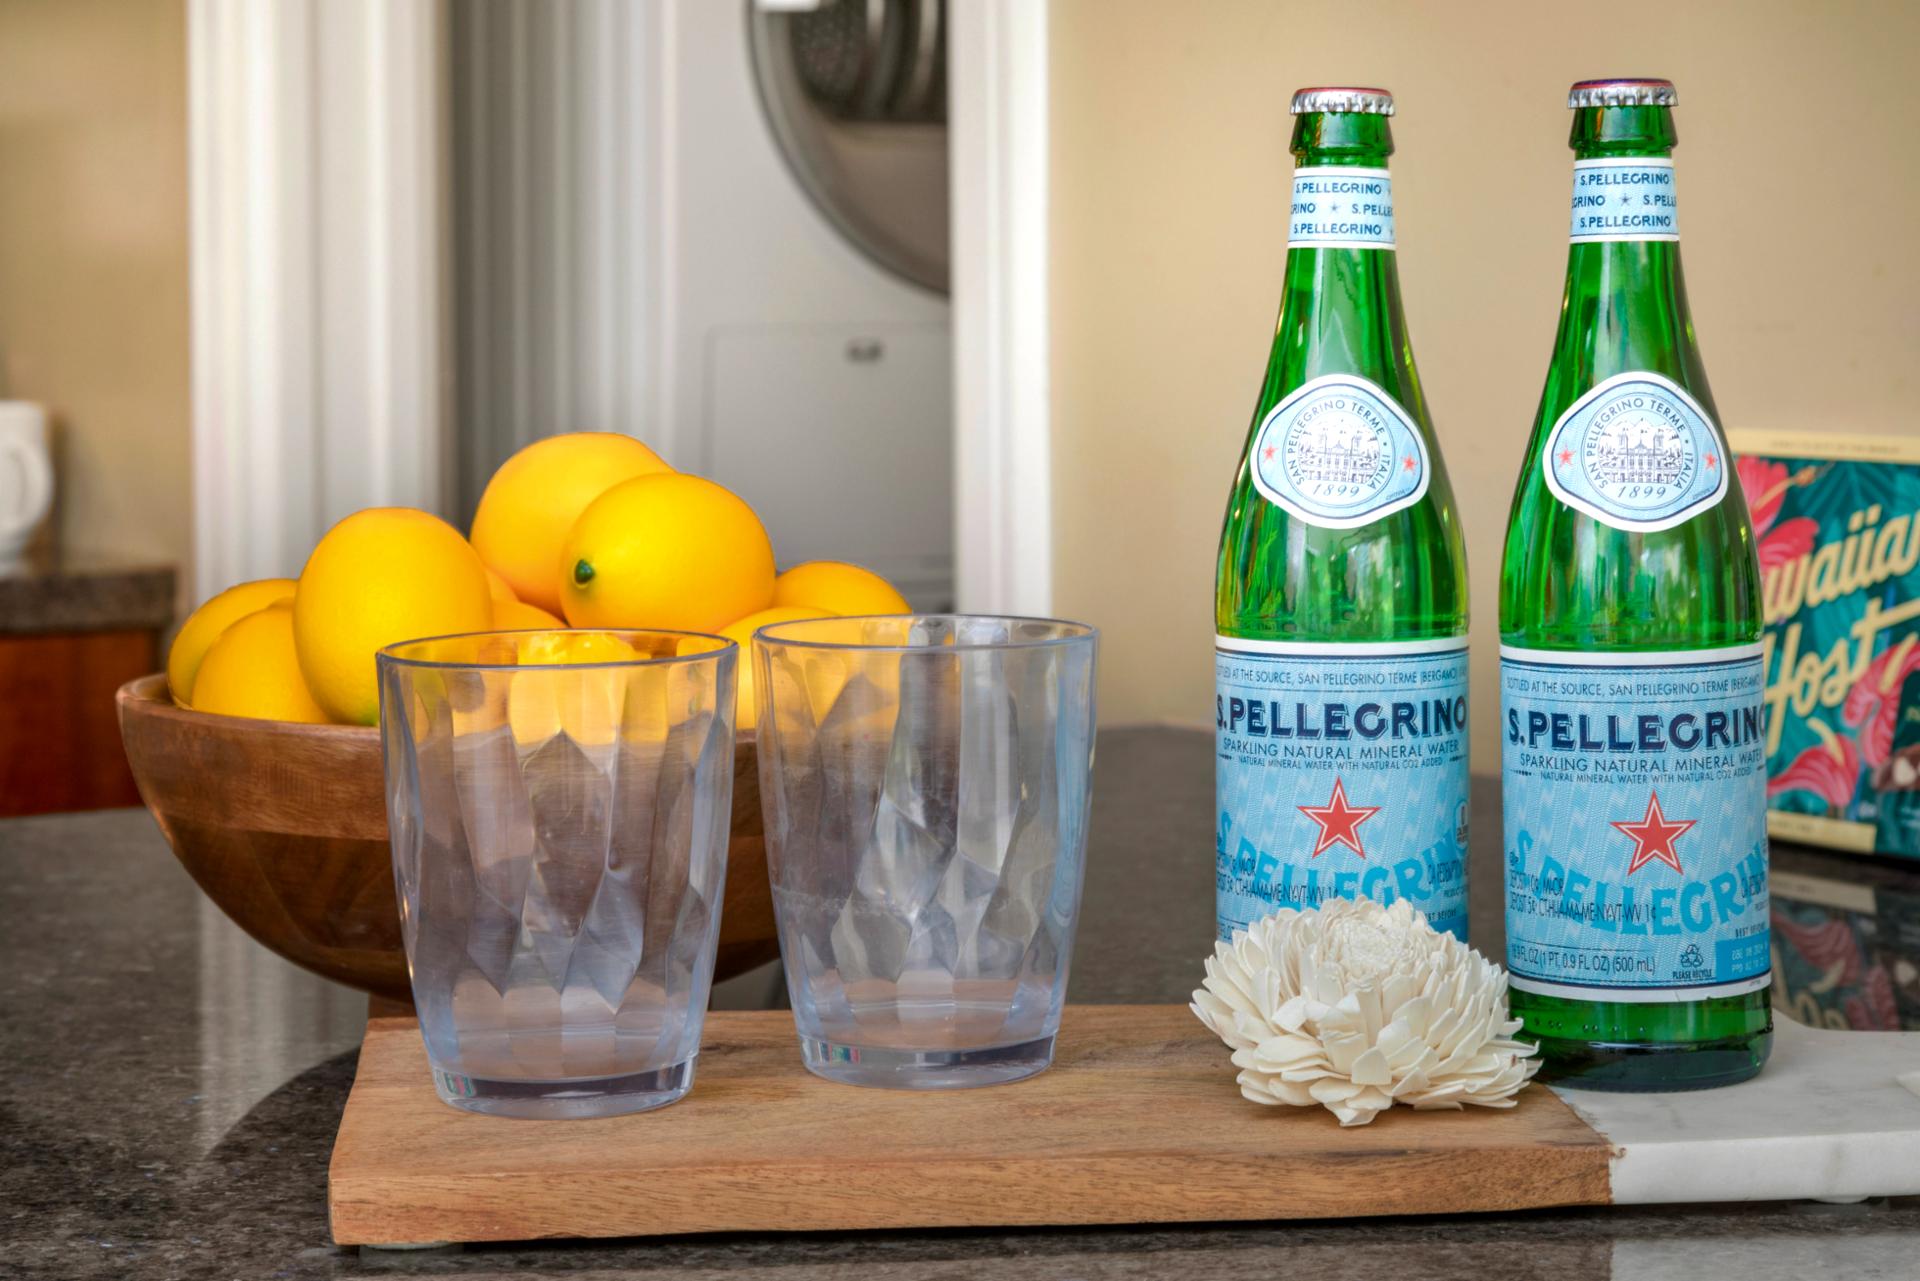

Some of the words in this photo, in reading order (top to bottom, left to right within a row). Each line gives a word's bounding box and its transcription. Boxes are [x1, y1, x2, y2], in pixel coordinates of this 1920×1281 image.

[1296, 183, 1382, 194] S.PELLEGRINO
[1580, 173, 1670, 186] S.PELLEGRINO
[1294, 223, 1382, 235] S.PELLEGRINO
[1580, 215, 1671, 228] S.PELLEGRINO
[1288, 400, 1345, 453] PELLEGRINO
[1352, 403, 1385, 435] TERME
[1650, 399, 1686, 433] TERME
[1586, 397, 1644, 457] PELLEGRINO
[1288, 460, 1305, 486] SAN
[1367, 454, 1391, 490] ITALIA
[1587, 462, 1608, 489] SAN
[1674, 452, 1694, 490] ITALIA
[1313, 484, 1360, 498] 1899
[1617, 485, 1667, 499] 1899
[1298, 672, 1320, 685] SAN
[1324, 672, 1385, 686] PELLEGRINO
[1388, 671, 1417, 684] TERME
[1531, 681, 1540, 692] AT
[1542, 681, 1557, 694] THE
[1561, 683, 1605, 697] SOURCE,
[1609, 684, 1633, 696] SAN
[1637, 682, 1700, 696] PELLEGRINO
[1702, 679, 1728, 693] TERME
[1216, 694, 1468, 740] S.PELLEGRINO
[1224, 737, 1278, 757] SPARKLING
[1284, 745, 1353, 760] NATURAL
[1360, 744, 1422, 759] MINERAL
[1427, 739, 1460, 755] WATER
[1239, 755, 1265, 767] NATURAL
[1268, 759, 1301, 769] MINERAL
[1304, 760, 1333, 770] WATER
[1336, 761, 1359, 770] WITH
[1362, 760, 1400, 770] NATURAL
[1520, 753, 1587, 772] SPARKLING
[1595, 759, 1668, 773] NATURAL
[1674, 754, 1735, 771] MINERAL
[1540, 771, 1573, 782] NATURAL
[1576, 774, 1614, 784] MINERAL
[1617, 775, 1648, 784] WATER
[1652, 774, 1674, 784] WITH
[1677, 773, 1714, 783] NATURAL
[1529, 948, 1539, 965] OZ
[1563, 953, 1575, 969] 0.9
[1578, 954, 1590, 970] FL
[1593, 955, 1610, 975] OZ)
[1613, 956, 1634, 974] (500
